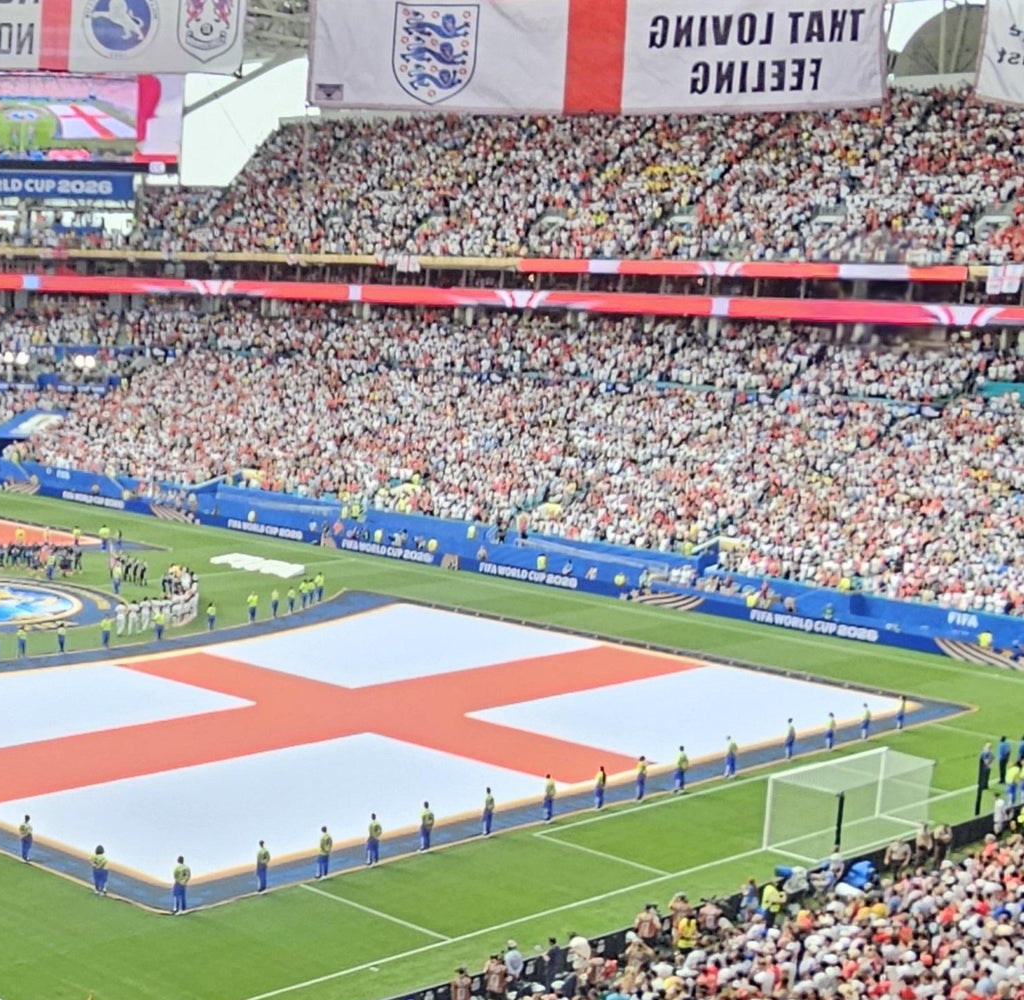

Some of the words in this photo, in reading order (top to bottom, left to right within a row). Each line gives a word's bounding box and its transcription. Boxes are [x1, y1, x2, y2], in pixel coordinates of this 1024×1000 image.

[24, 178, 56, 193] CUP
[58, 179, 113, 194] 2026
[479, 562, 497, 574] FIFA
[497, 564, 527, 579] WORLD
[528, 568, 546, 582] CUP
[750, 609, 774, 623] FIFA
[774, 612, 812, 631] WORLD
[814, 618, 837, 634] CUP
[948, 611, 979, 628] FIFA
